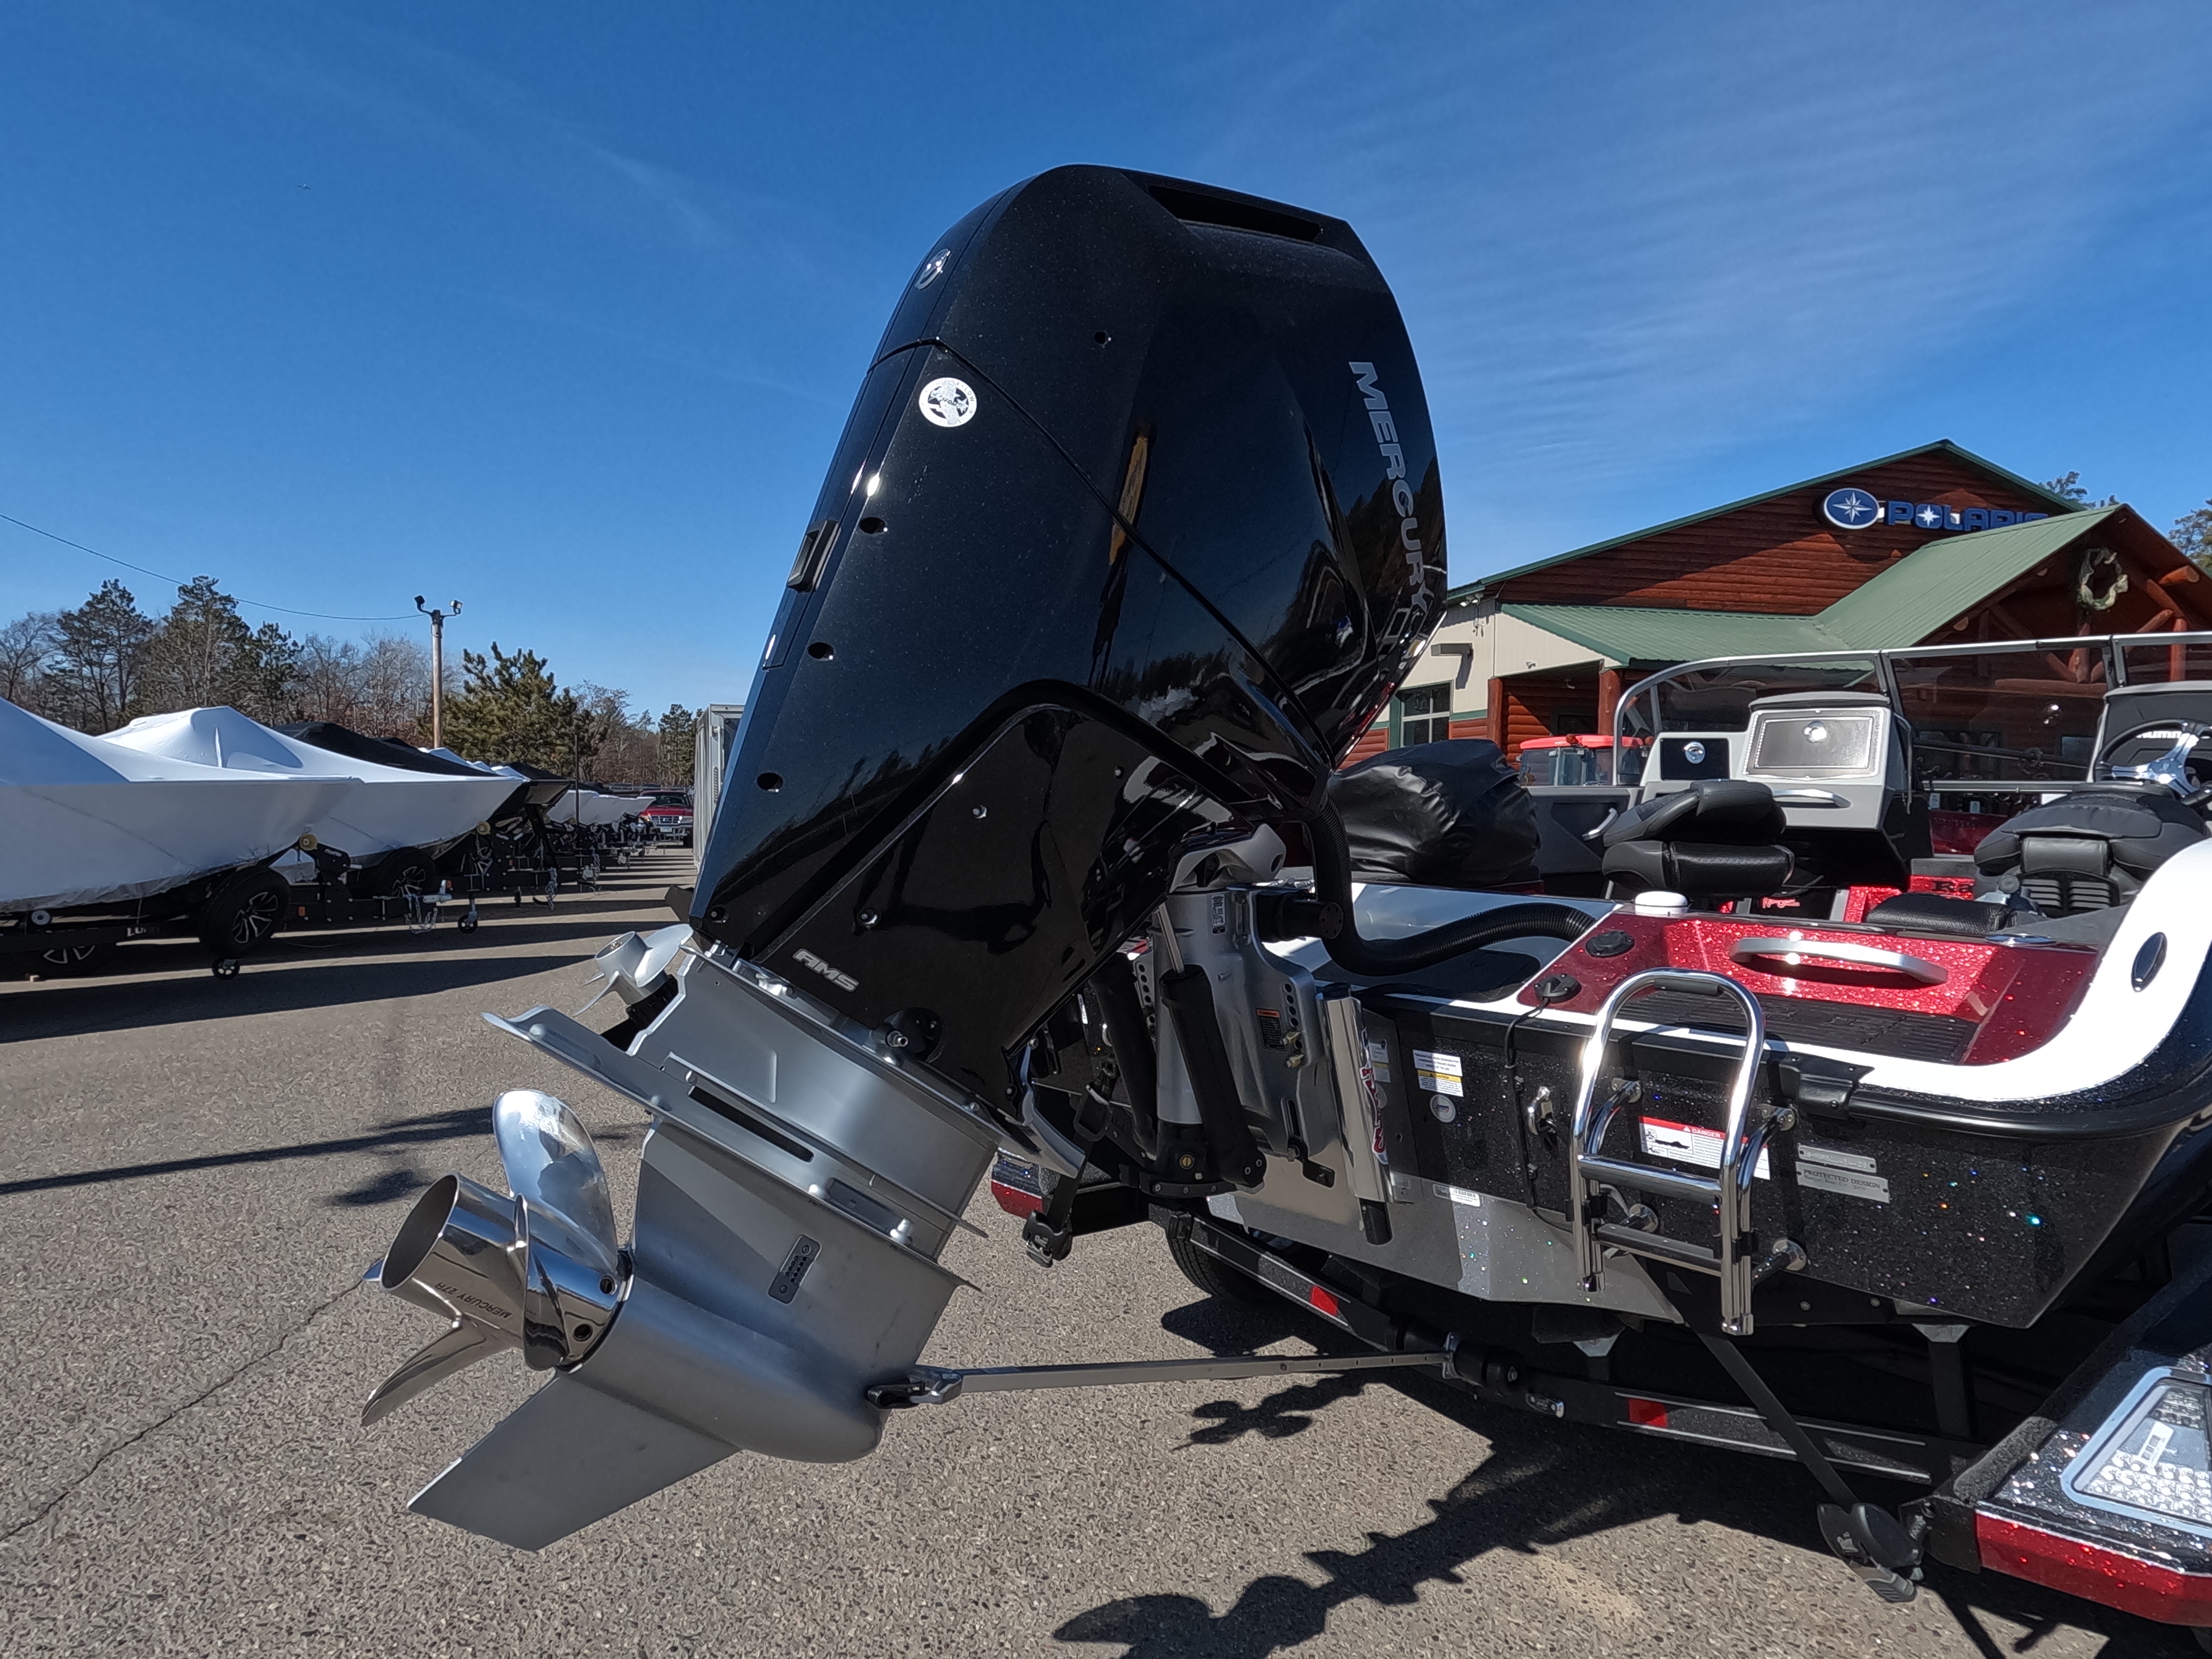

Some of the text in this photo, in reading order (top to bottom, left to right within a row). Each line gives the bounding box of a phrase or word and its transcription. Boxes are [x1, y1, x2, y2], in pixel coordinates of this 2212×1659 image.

[1349, 362, 1435, 613] MERCURY
[793, 949, 859, 992] AMS
[1691, 1128, 1721, 1138] DANGER
[1804, 1169, 1849, 1183] PROTECTED
[1851, 1178, 1881, 1189] DESIGN
[456, 1293, 512, 1319] MERCURY
